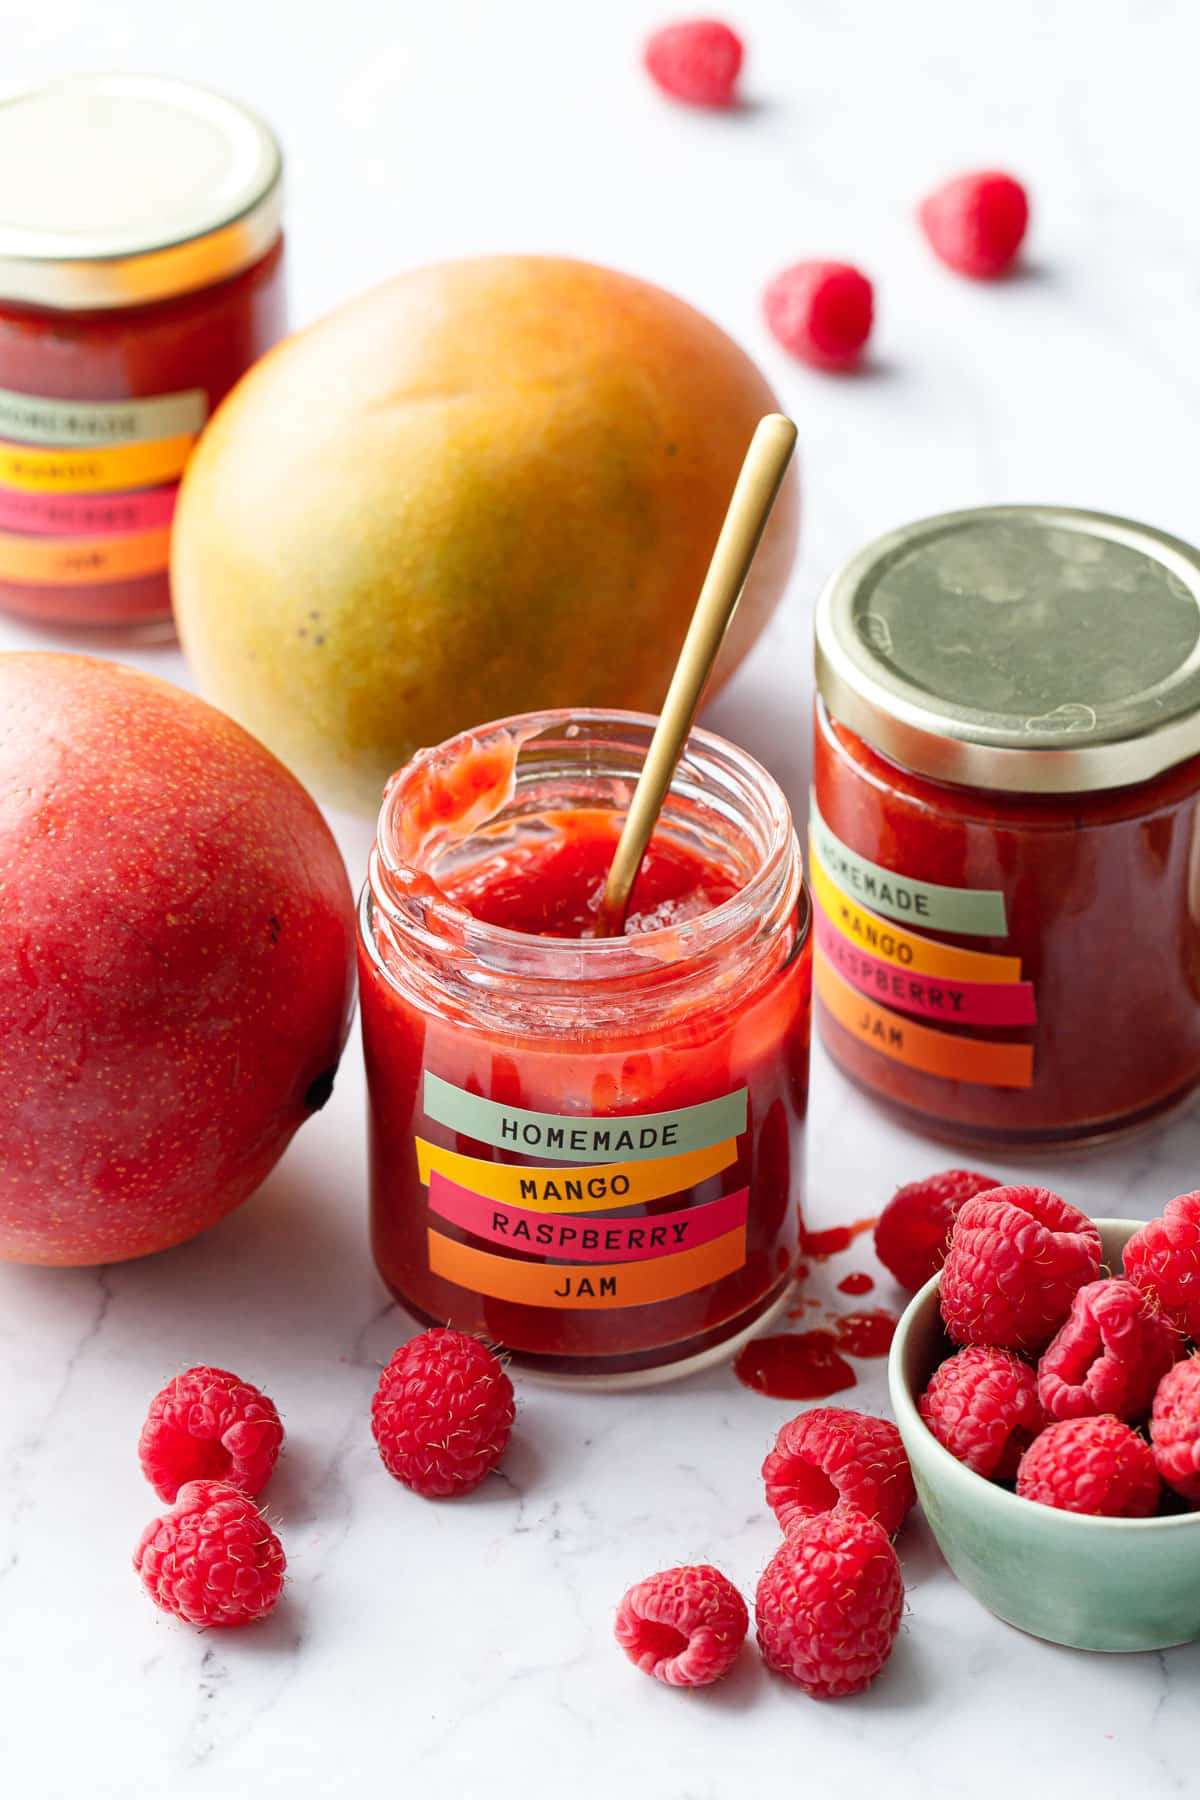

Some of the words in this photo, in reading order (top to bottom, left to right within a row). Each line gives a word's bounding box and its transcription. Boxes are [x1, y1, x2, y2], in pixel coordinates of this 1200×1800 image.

[840, 905, 914, 965] MANGO
[860, 1013, 904, 1049] JAM
[501, 1117, 679, 1151] HOMEMADE
[519, 1174, 631, 1201] MANGO
[492, 1211, 690, 1250] RASPBERRY
[554, 1276, 618, 1297] JAM
